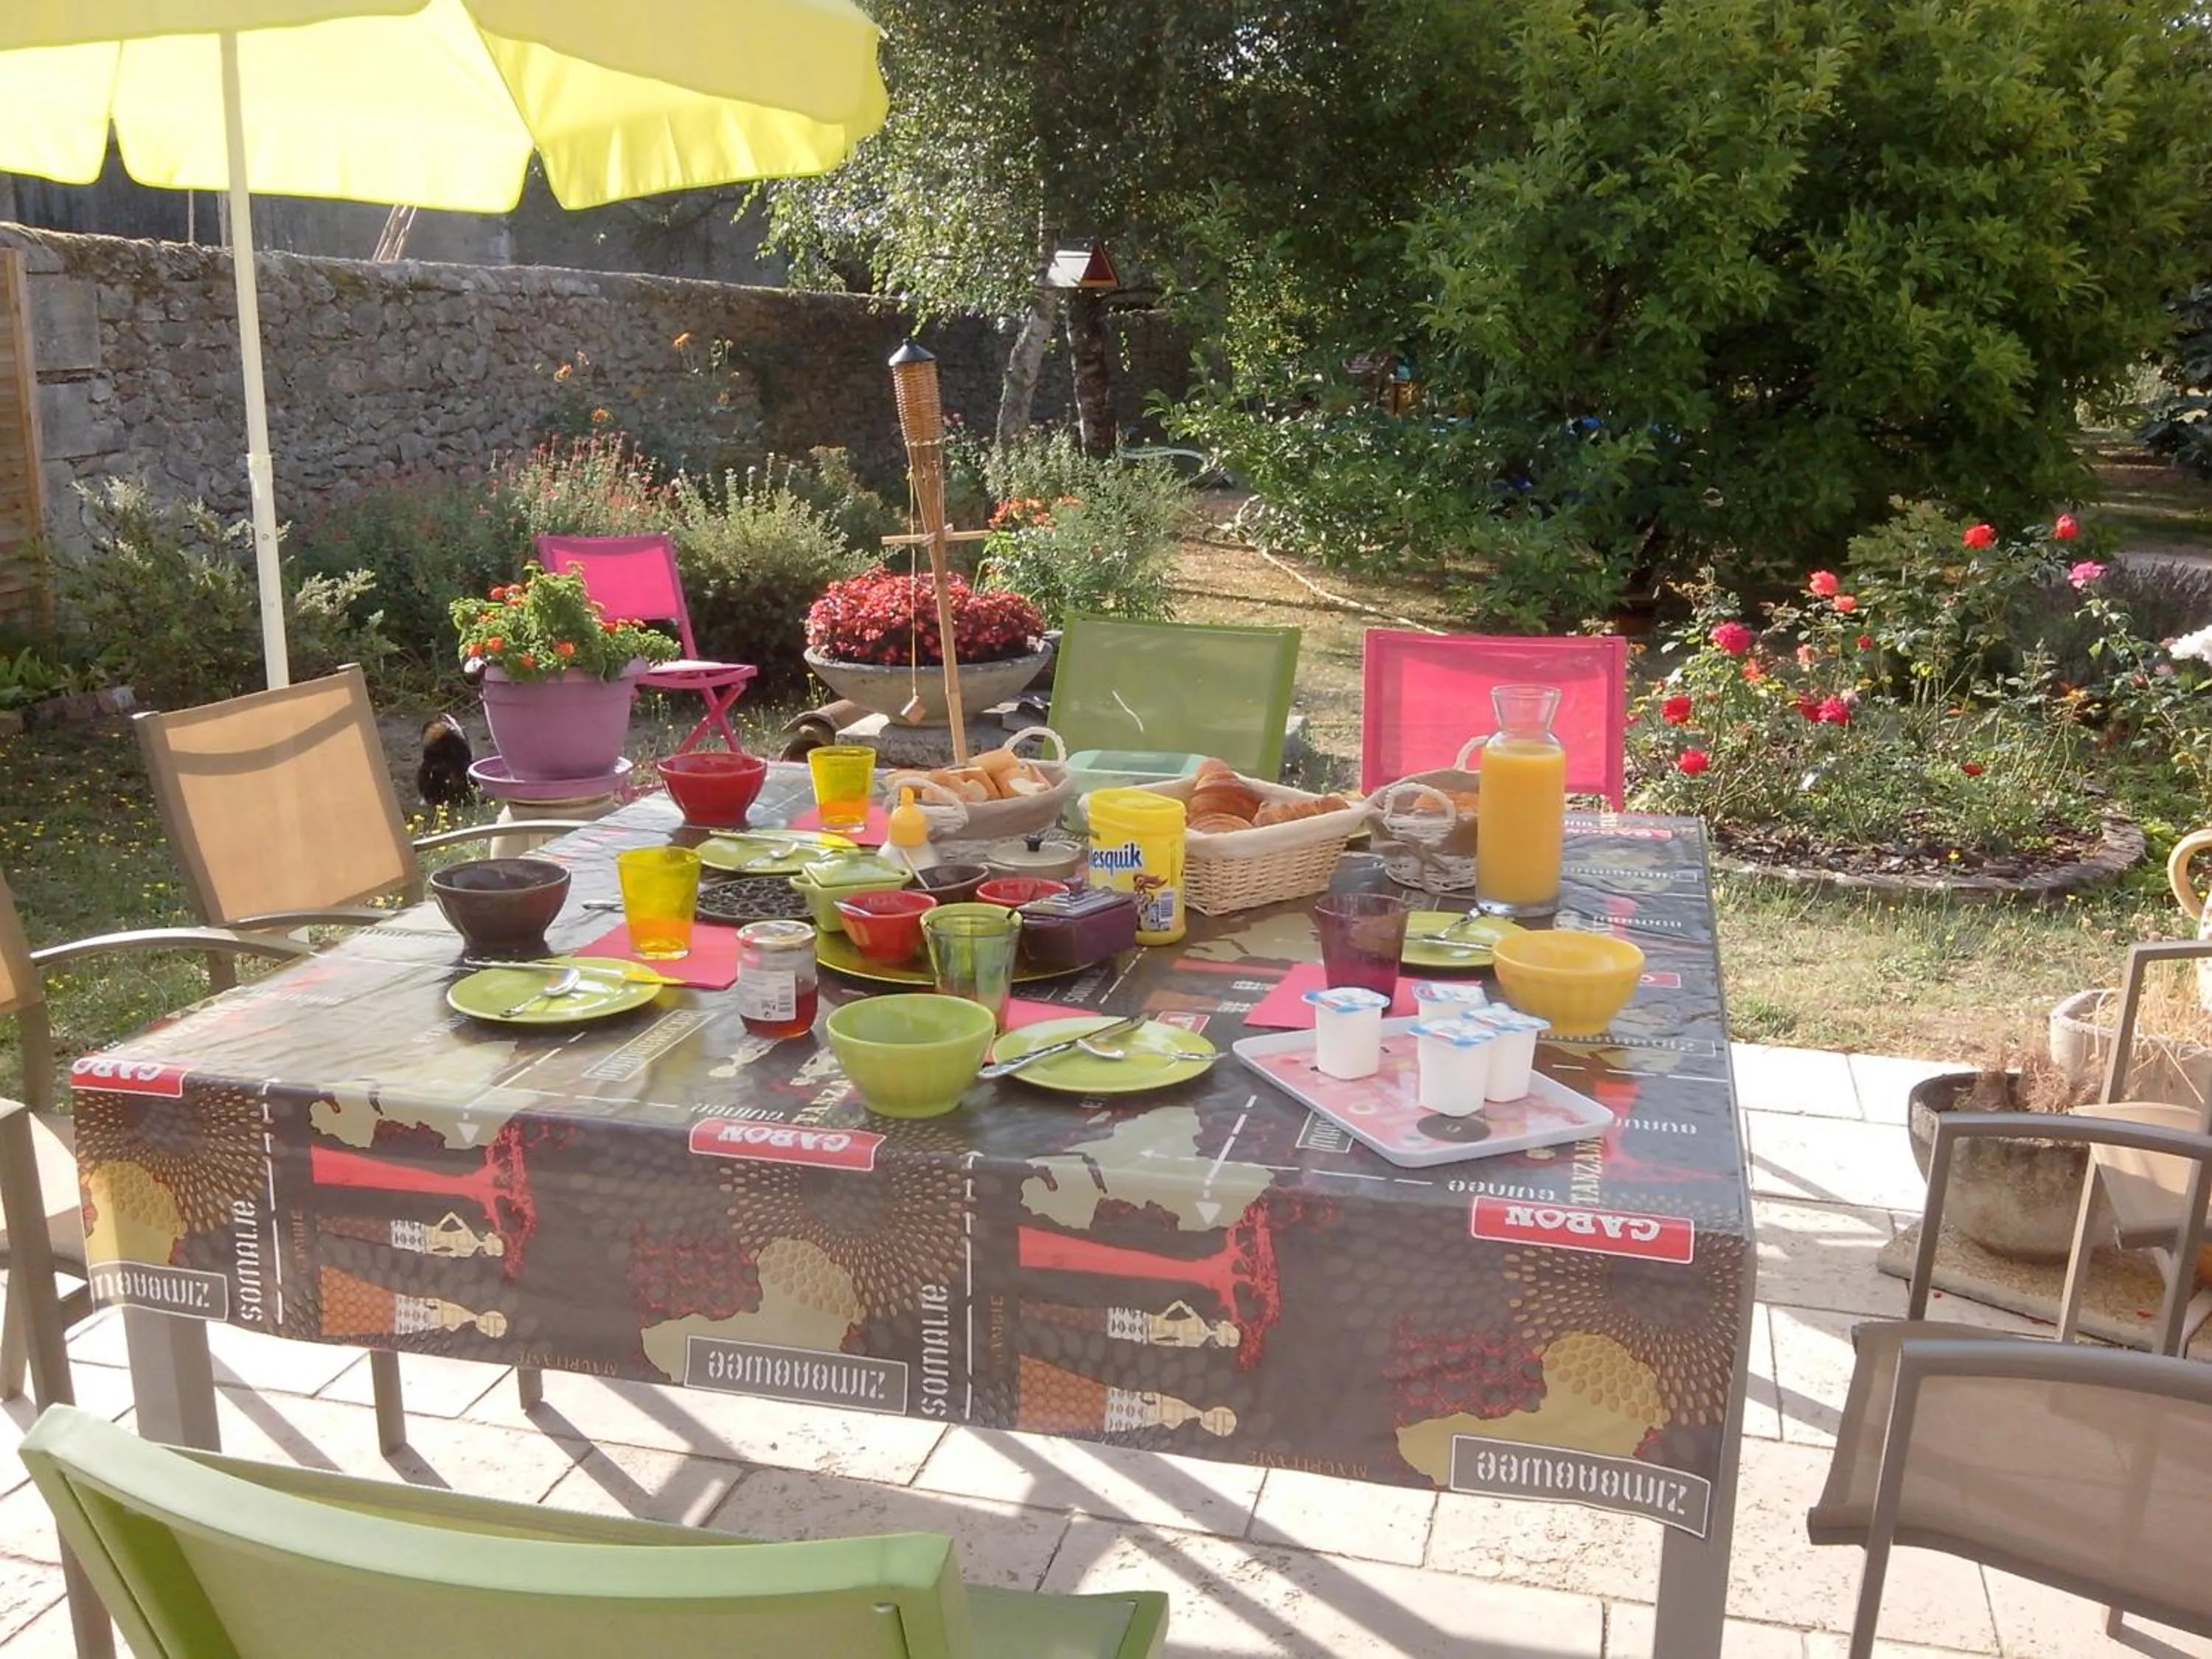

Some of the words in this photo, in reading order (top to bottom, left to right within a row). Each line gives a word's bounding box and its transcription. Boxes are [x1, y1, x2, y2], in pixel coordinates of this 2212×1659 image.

[70, 1057, 162, 1081] GABO
[792, 1077, 854, 1123] TANZA
[717, 1125, 851, 1152] GABON
[1571, 1136, 1603, 1203] TANZAN
[1505, 1206, 1661, 1241] GABON
[233, 1200, 262, 1321] SOMALIE
[93, 1272, 210, 1308] ZIMBABW
[920, 1284, 949, 1416] SOMALIE
